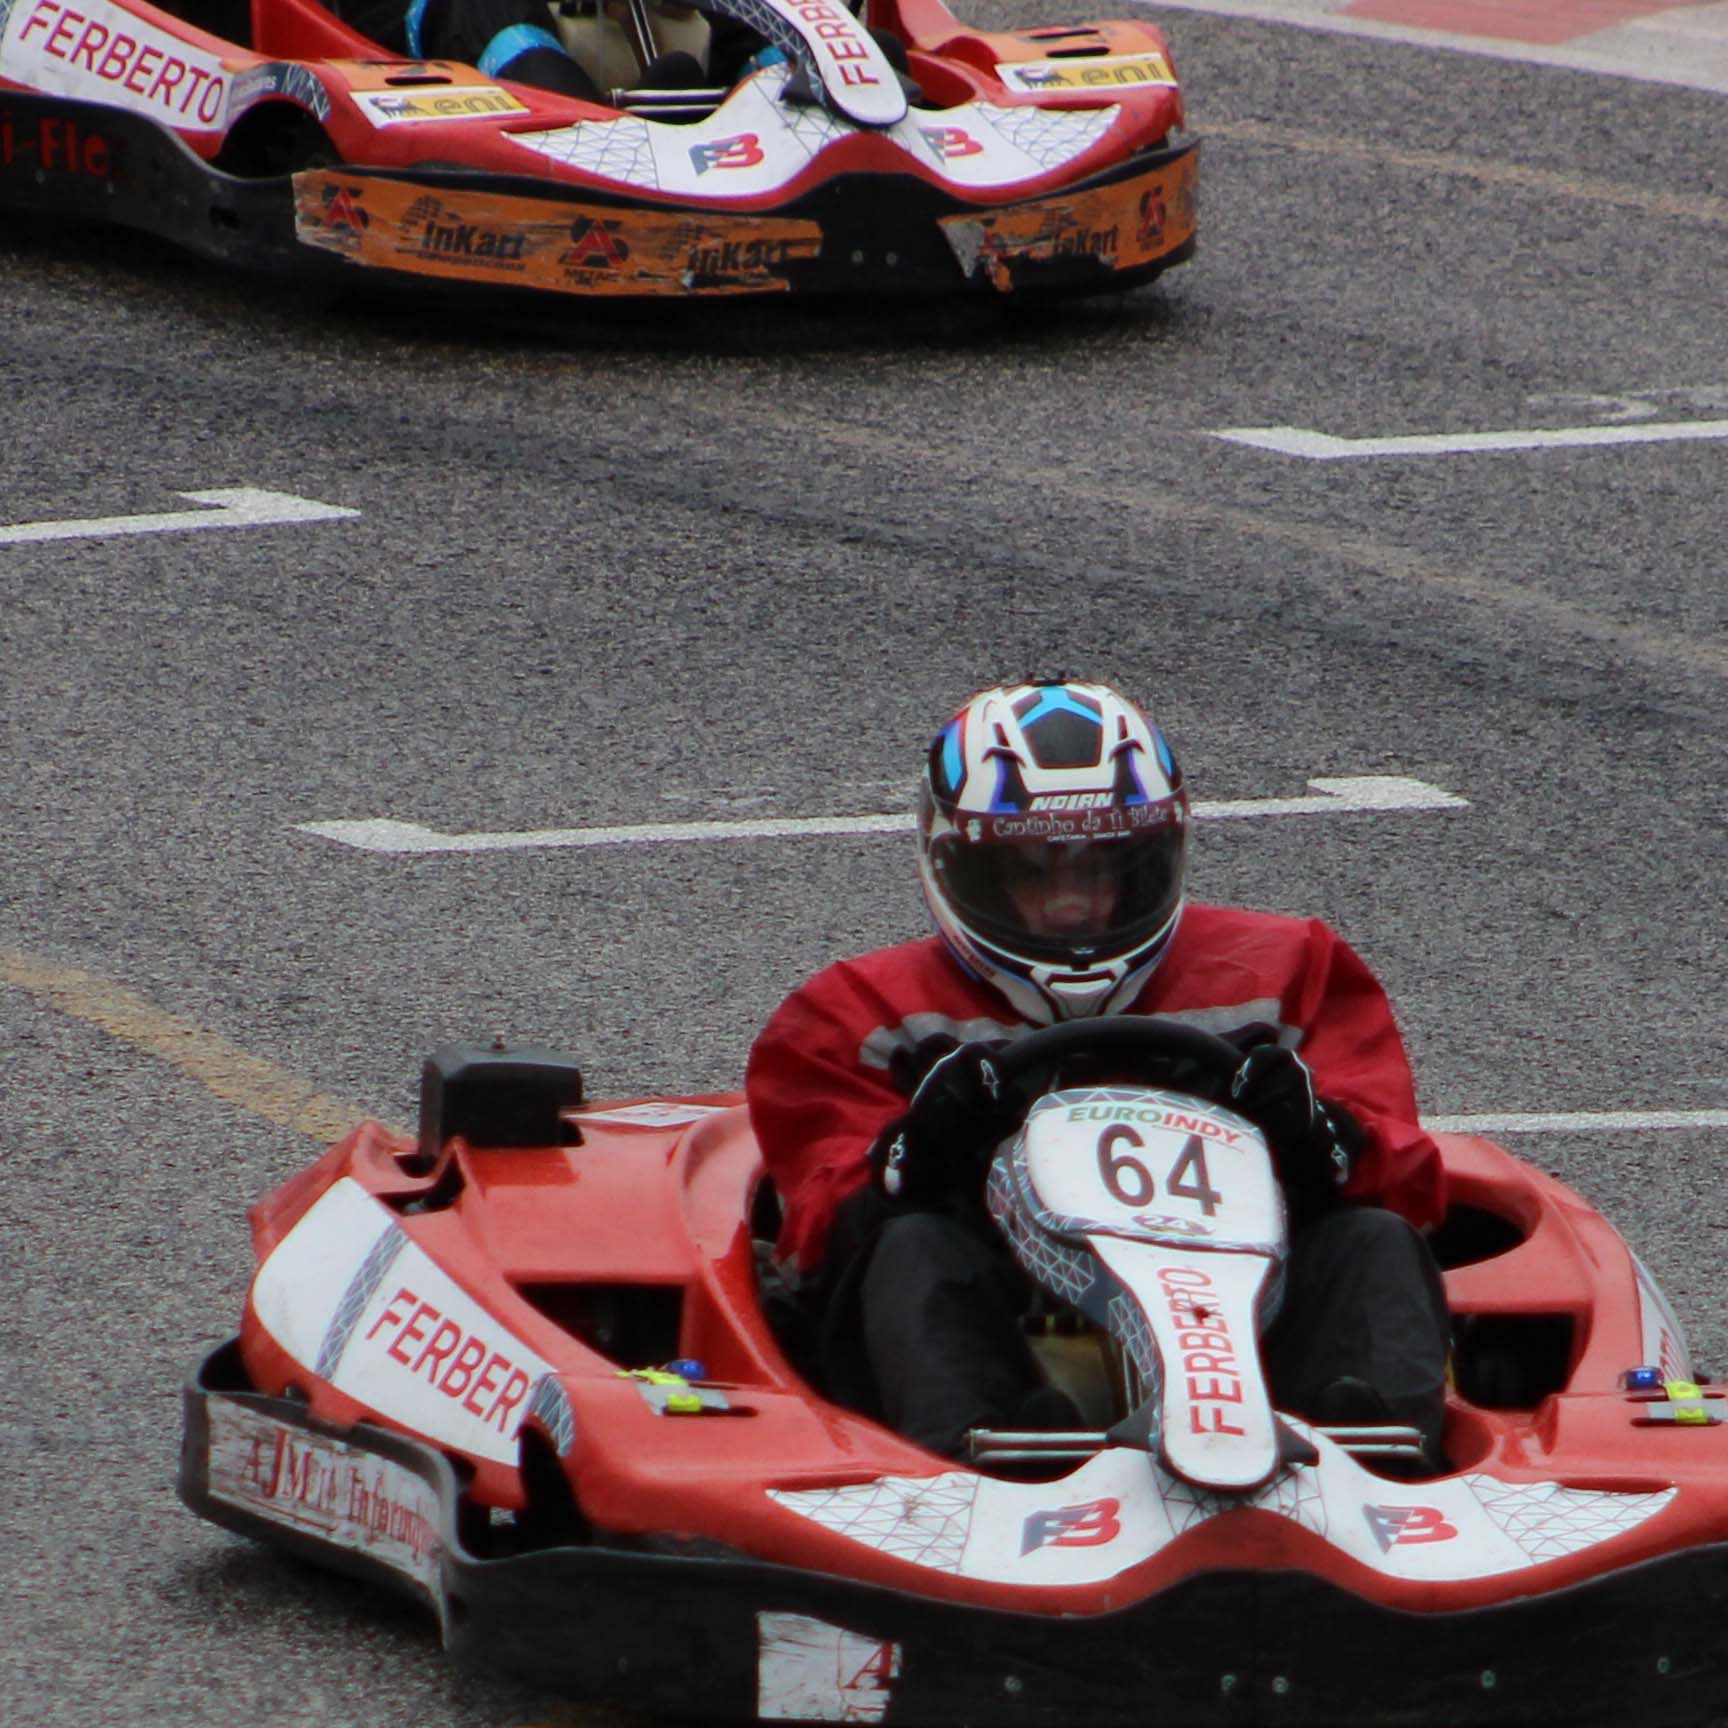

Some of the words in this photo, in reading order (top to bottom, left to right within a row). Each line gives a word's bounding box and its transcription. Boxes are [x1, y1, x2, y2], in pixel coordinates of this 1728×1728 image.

[19, 0, 225, 124] FERBERTO
[785, 0, 881, 86] FERB
[1081, 62, 1164, 85] eni
[434, 94, 513, 115] eni
[992, 812, 1075, 838] Cantinho
[1067, 1105, 1243, 1144] EUROINDY
[1097, 1123, 1223, 1218] 64
[1157, 1267, 1248, 1437] FERBERTO
